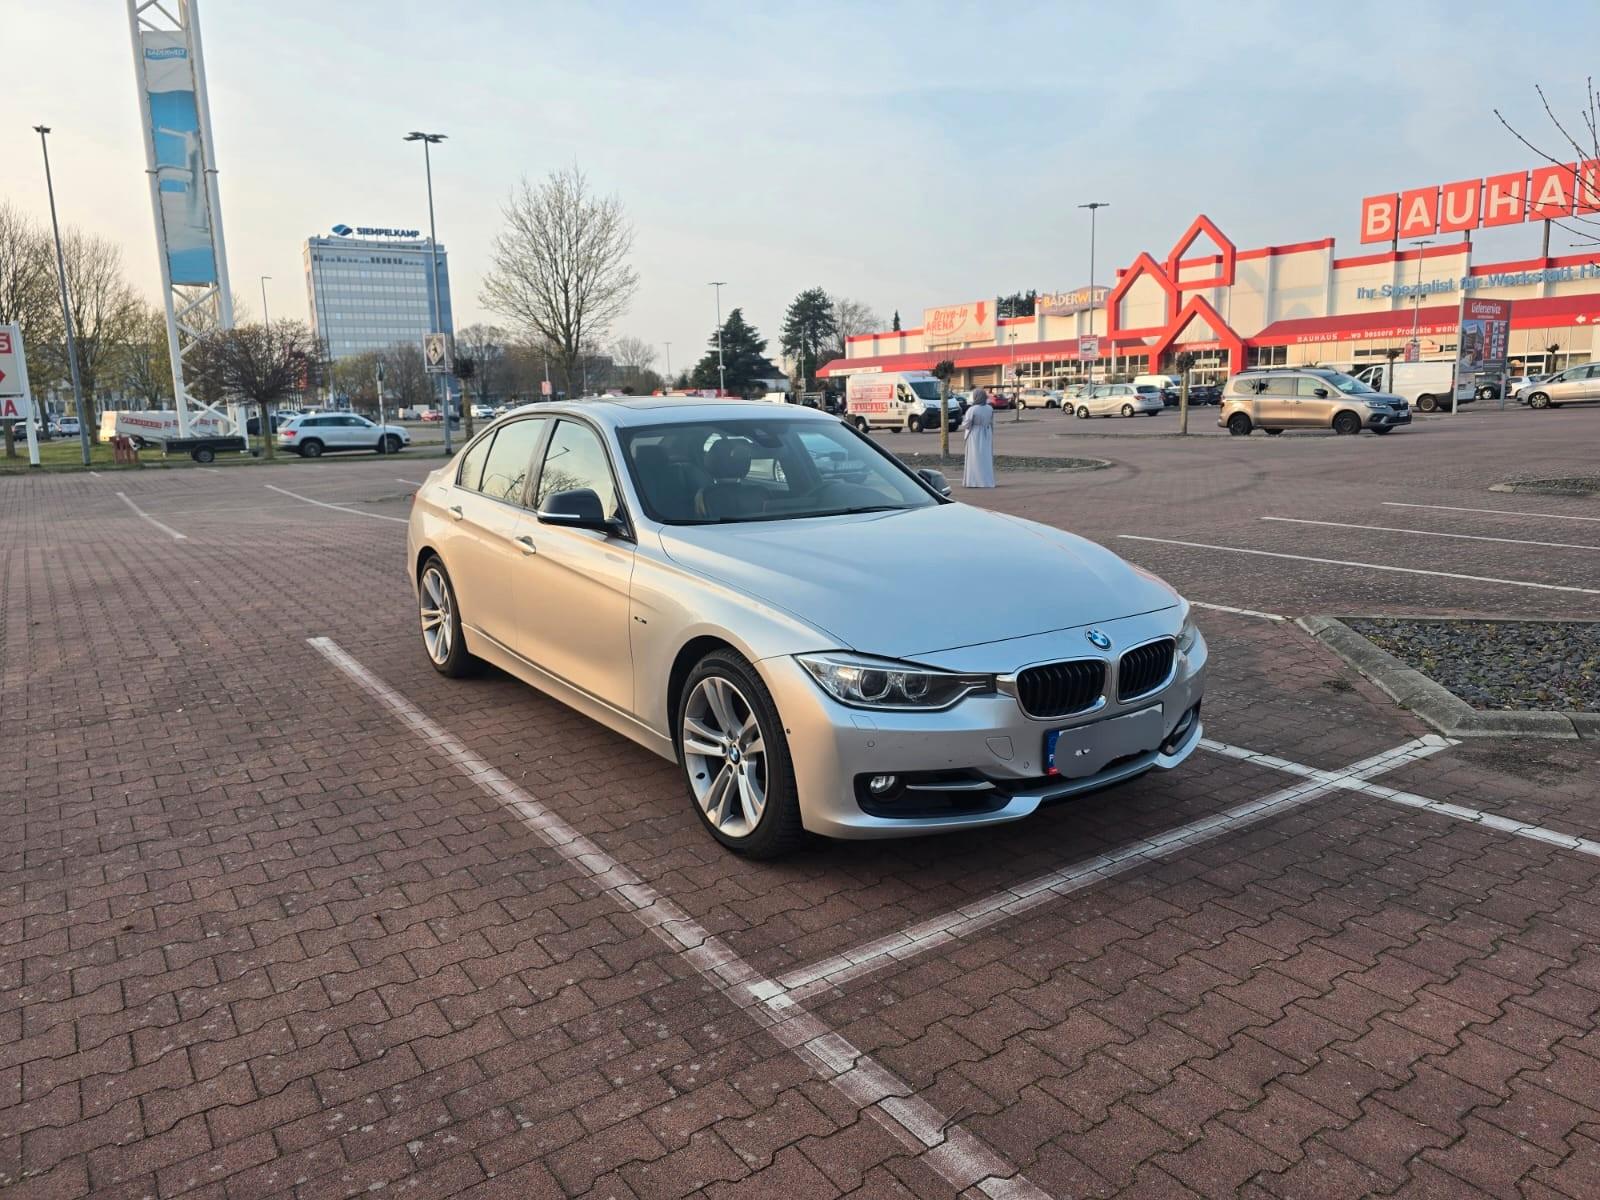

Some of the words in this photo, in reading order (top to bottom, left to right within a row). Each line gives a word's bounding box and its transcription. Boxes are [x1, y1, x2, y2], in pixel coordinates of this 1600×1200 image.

[357, 227, 420, 237] SIEMPELKAMP
[1357, 287, 1375, 299] Ihr
[1381, 278, 1453, 297] Spezialist
[1487, 266, 1573, 287] Werkstatt
[926, 319, 954, 332] ARENA
[1297, 332, 1338, 343] BAUHAUS
[1364, 329, 1394, 338] bessere
